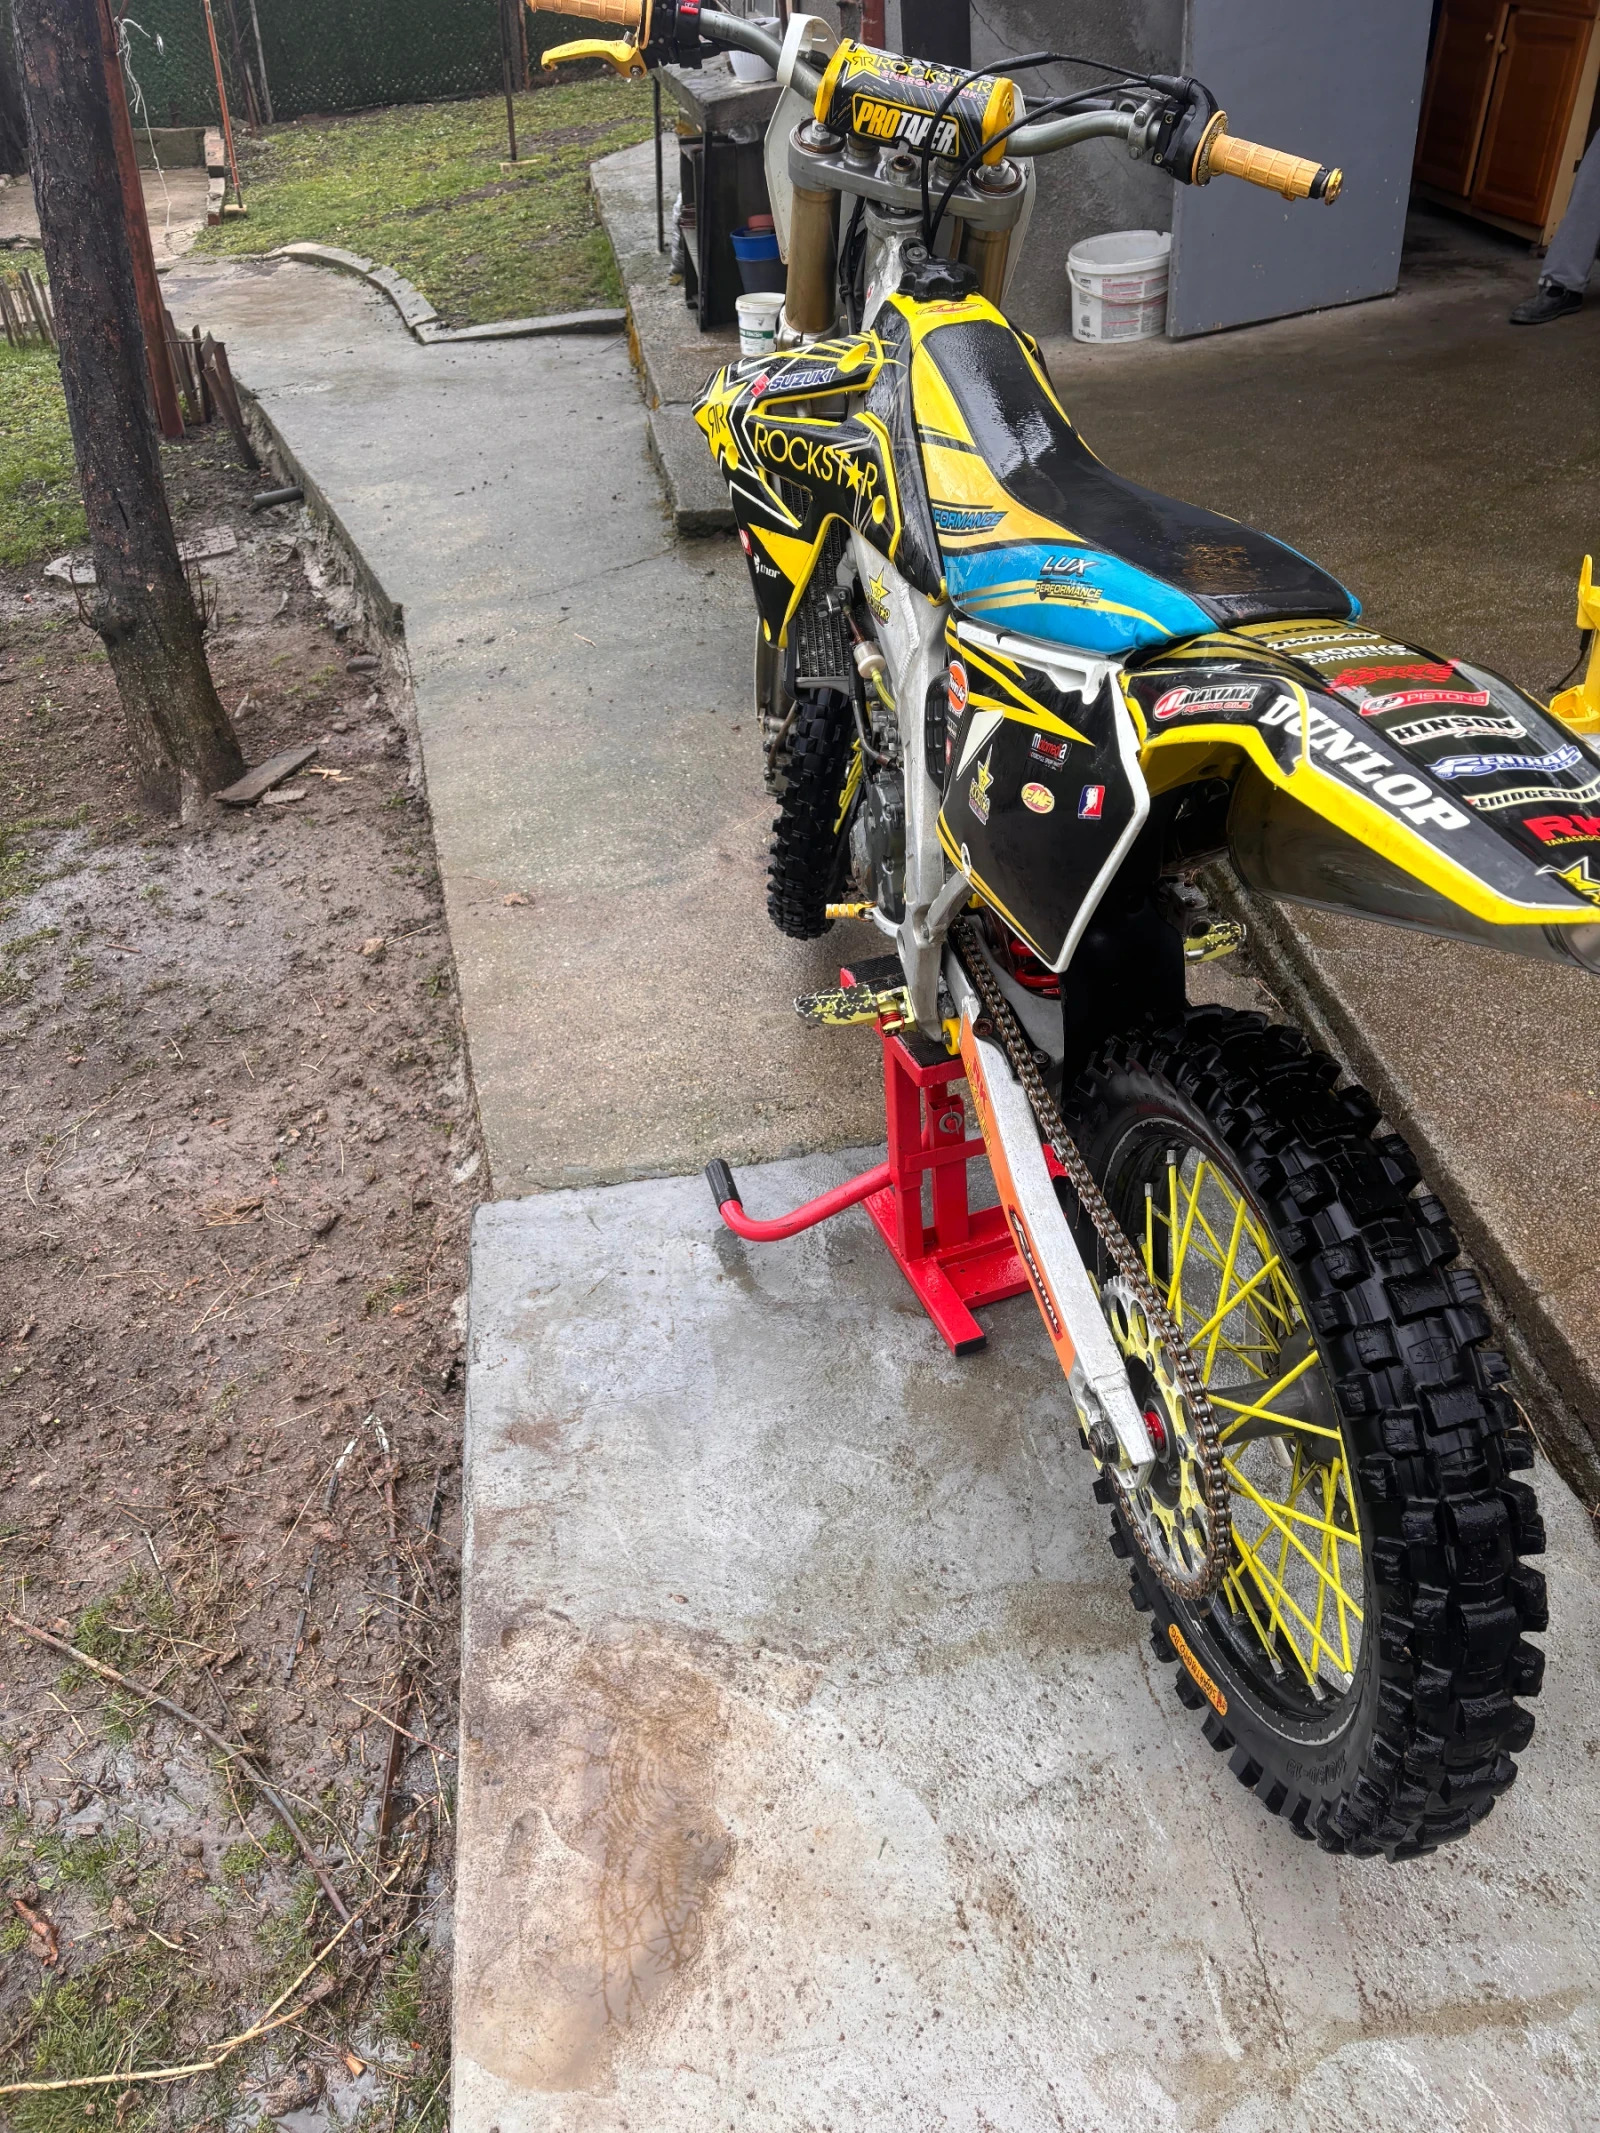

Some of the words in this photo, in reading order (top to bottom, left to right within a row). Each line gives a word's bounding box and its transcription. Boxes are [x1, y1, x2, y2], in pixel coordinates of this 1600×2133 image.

[880, 70, 935, 89] ENERGY
[769, 367, 836, 391] SUZUKI
[754, 422, 878, 500] ROCKSTAR
[931, 507, 1008, 530] FORMANCE
[760, 564, 781, 578] thor
[1040, 554, 1102, 577] LUX
[1034, 582, 1104, 600] PERFORMANCE
[1289, 644, 1406, 660] WORKS
[1184, 702, 1222, 713] RACING
[1223, 701, 1251, 710] OILS
[1406, 692, 1487, 703] PISTONS
[1391, 717, 1516, 740] HINSON
[1258, 693, 1471, 831] DUNLOP
[1022, 787, 1053, 807] FMF
